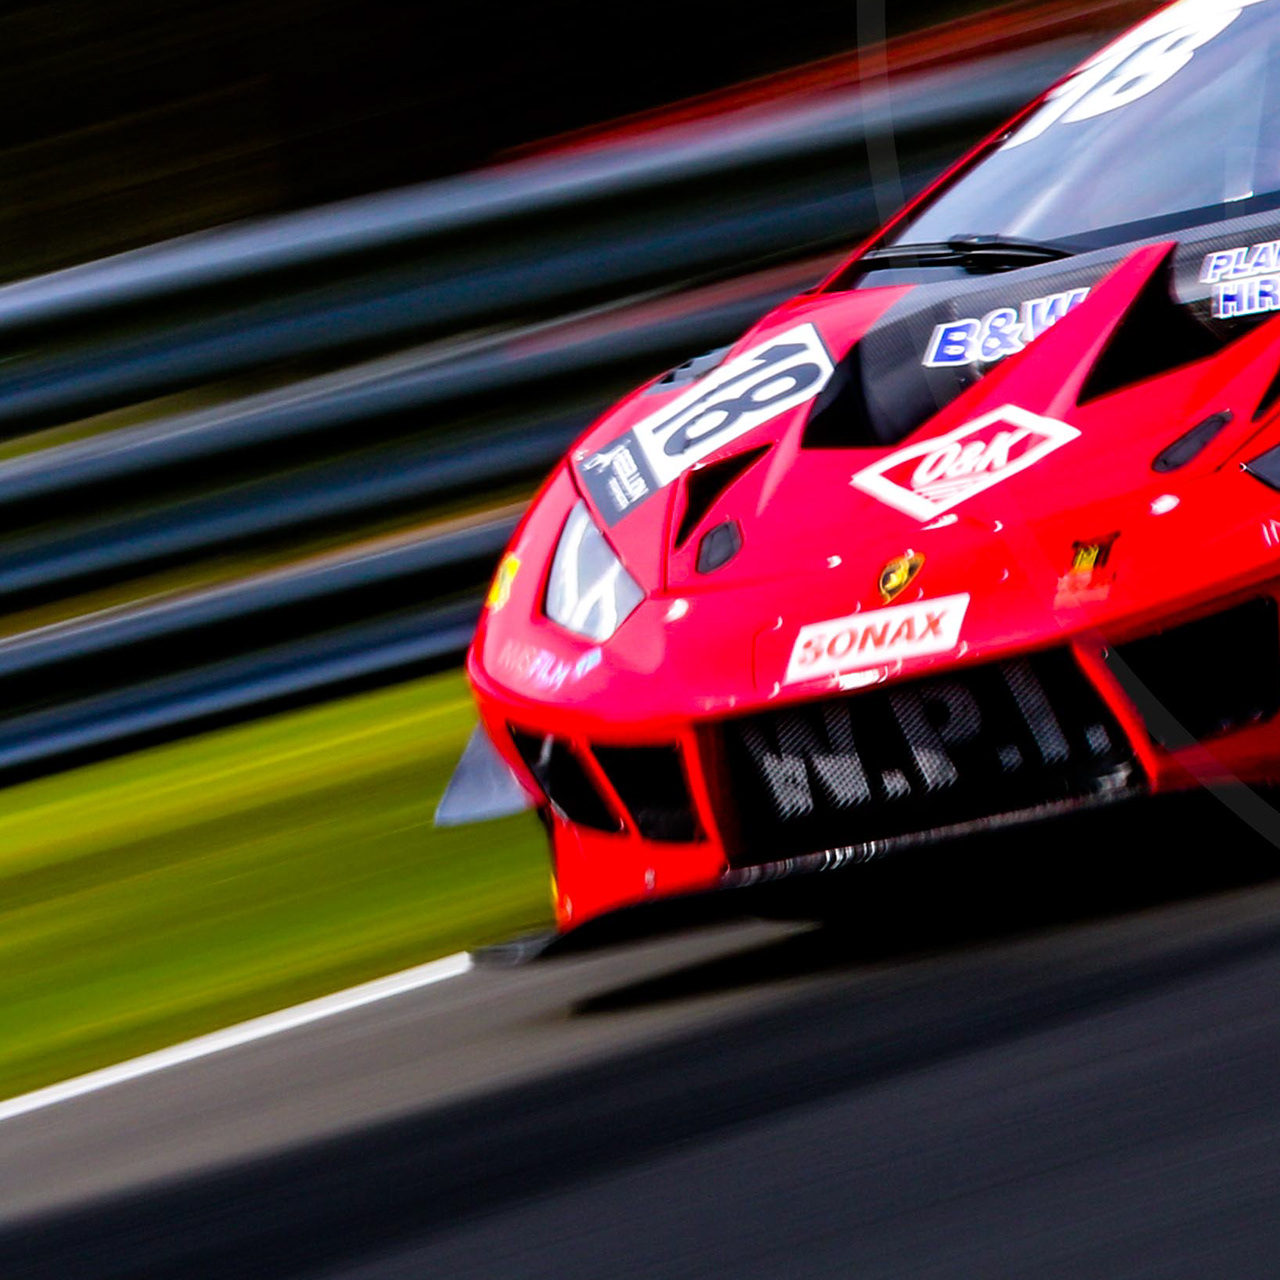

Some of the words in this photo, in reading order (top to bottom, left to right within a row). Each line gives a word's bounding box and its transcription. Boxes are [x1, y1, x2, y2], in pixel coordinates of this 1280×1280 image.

[922, 287, 1092, 368] B&W
[652, 341, 822, 457] 18
[798, 607, 949, 667] SONAX
[738, 658, 1113, 822] W.P.I.
